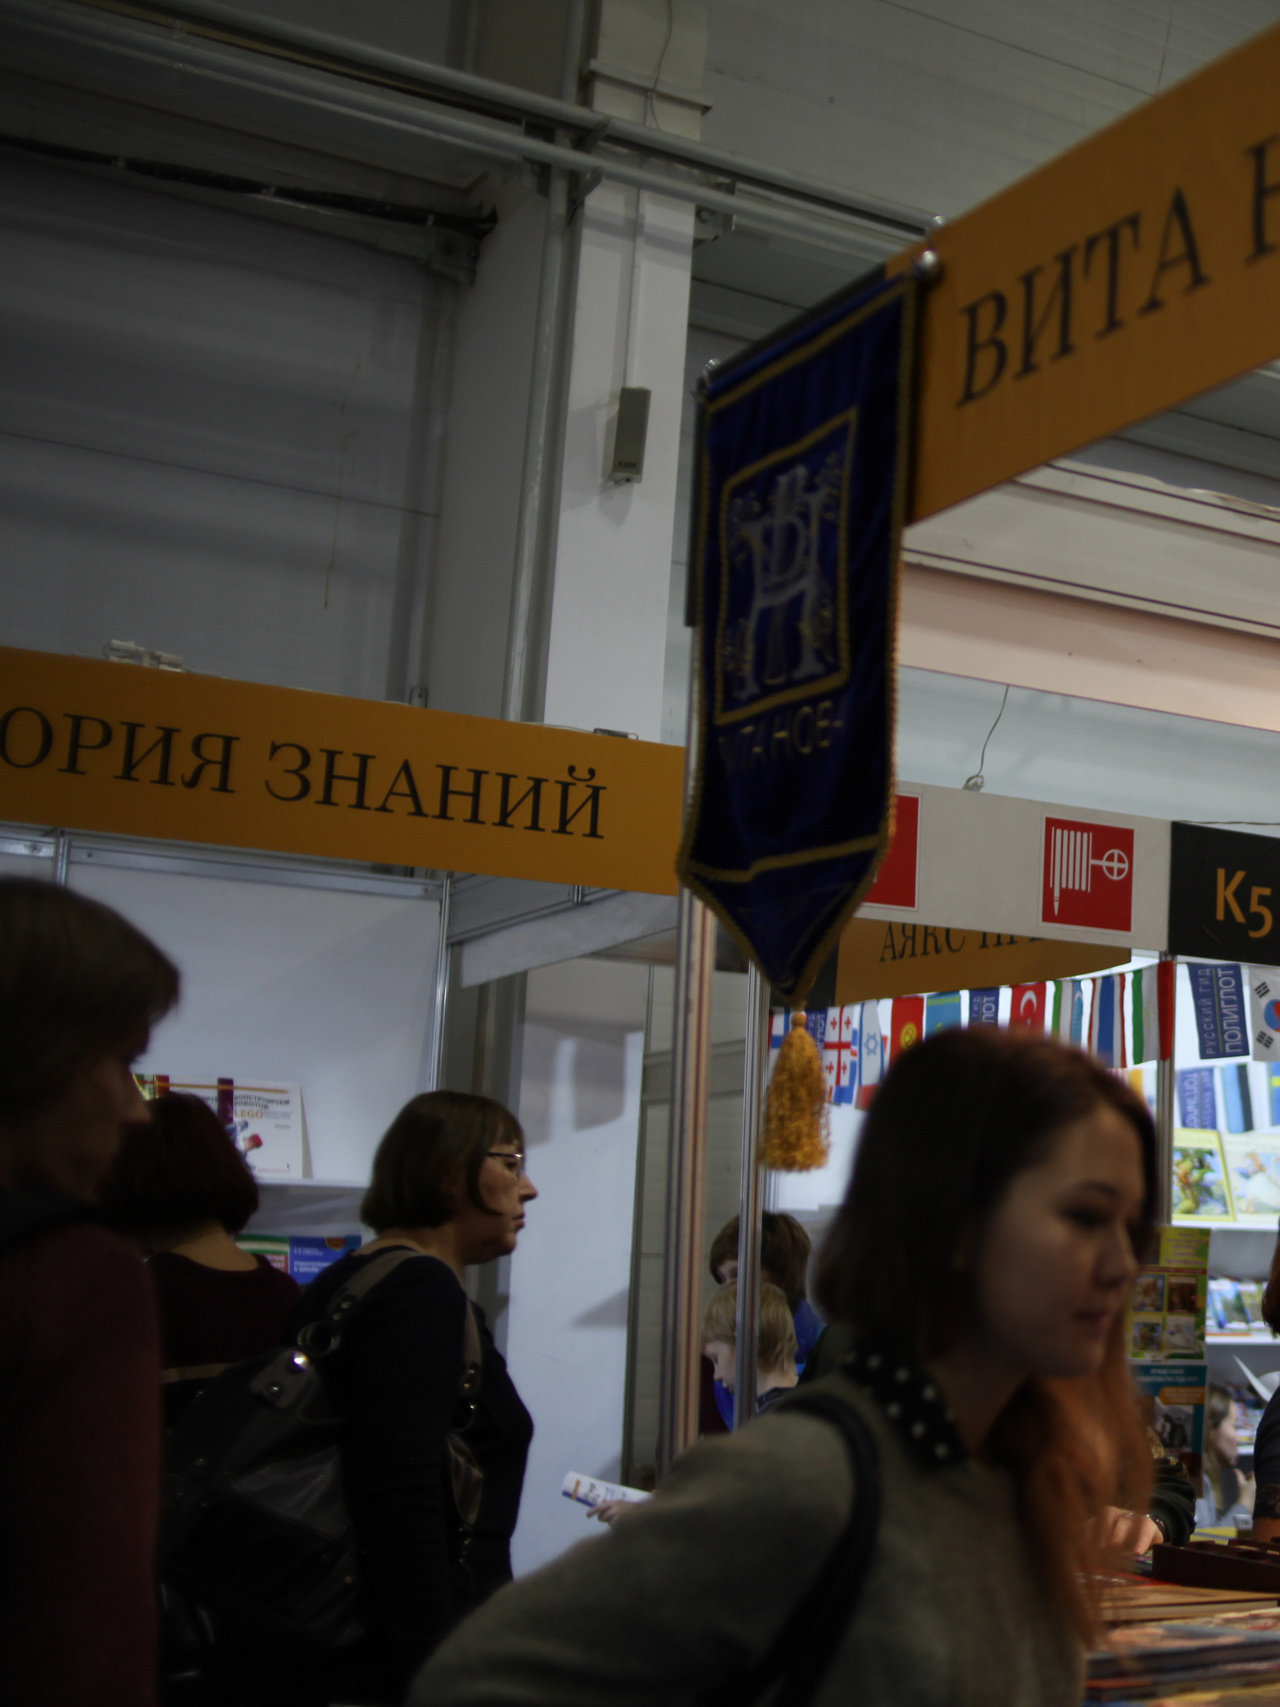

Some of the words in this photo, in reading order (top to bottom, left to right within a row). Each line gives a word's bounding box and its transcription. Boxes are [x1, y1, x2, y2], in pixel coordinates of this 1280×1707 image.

[956, 186, 1210, 408] ВИТА
[0, 706, 240, 794] ОРИЯ
[264, 740, 607, 839] ЗНАНИЙ
[1197, 967, 1211, 993] ГИД
[1217, 967, 1242, 1054] ПОЛИГЛОТ
[1199, 998, 1217, 1055] РУССКИЙ
[234, 1109, 264, 1119] LEGO
